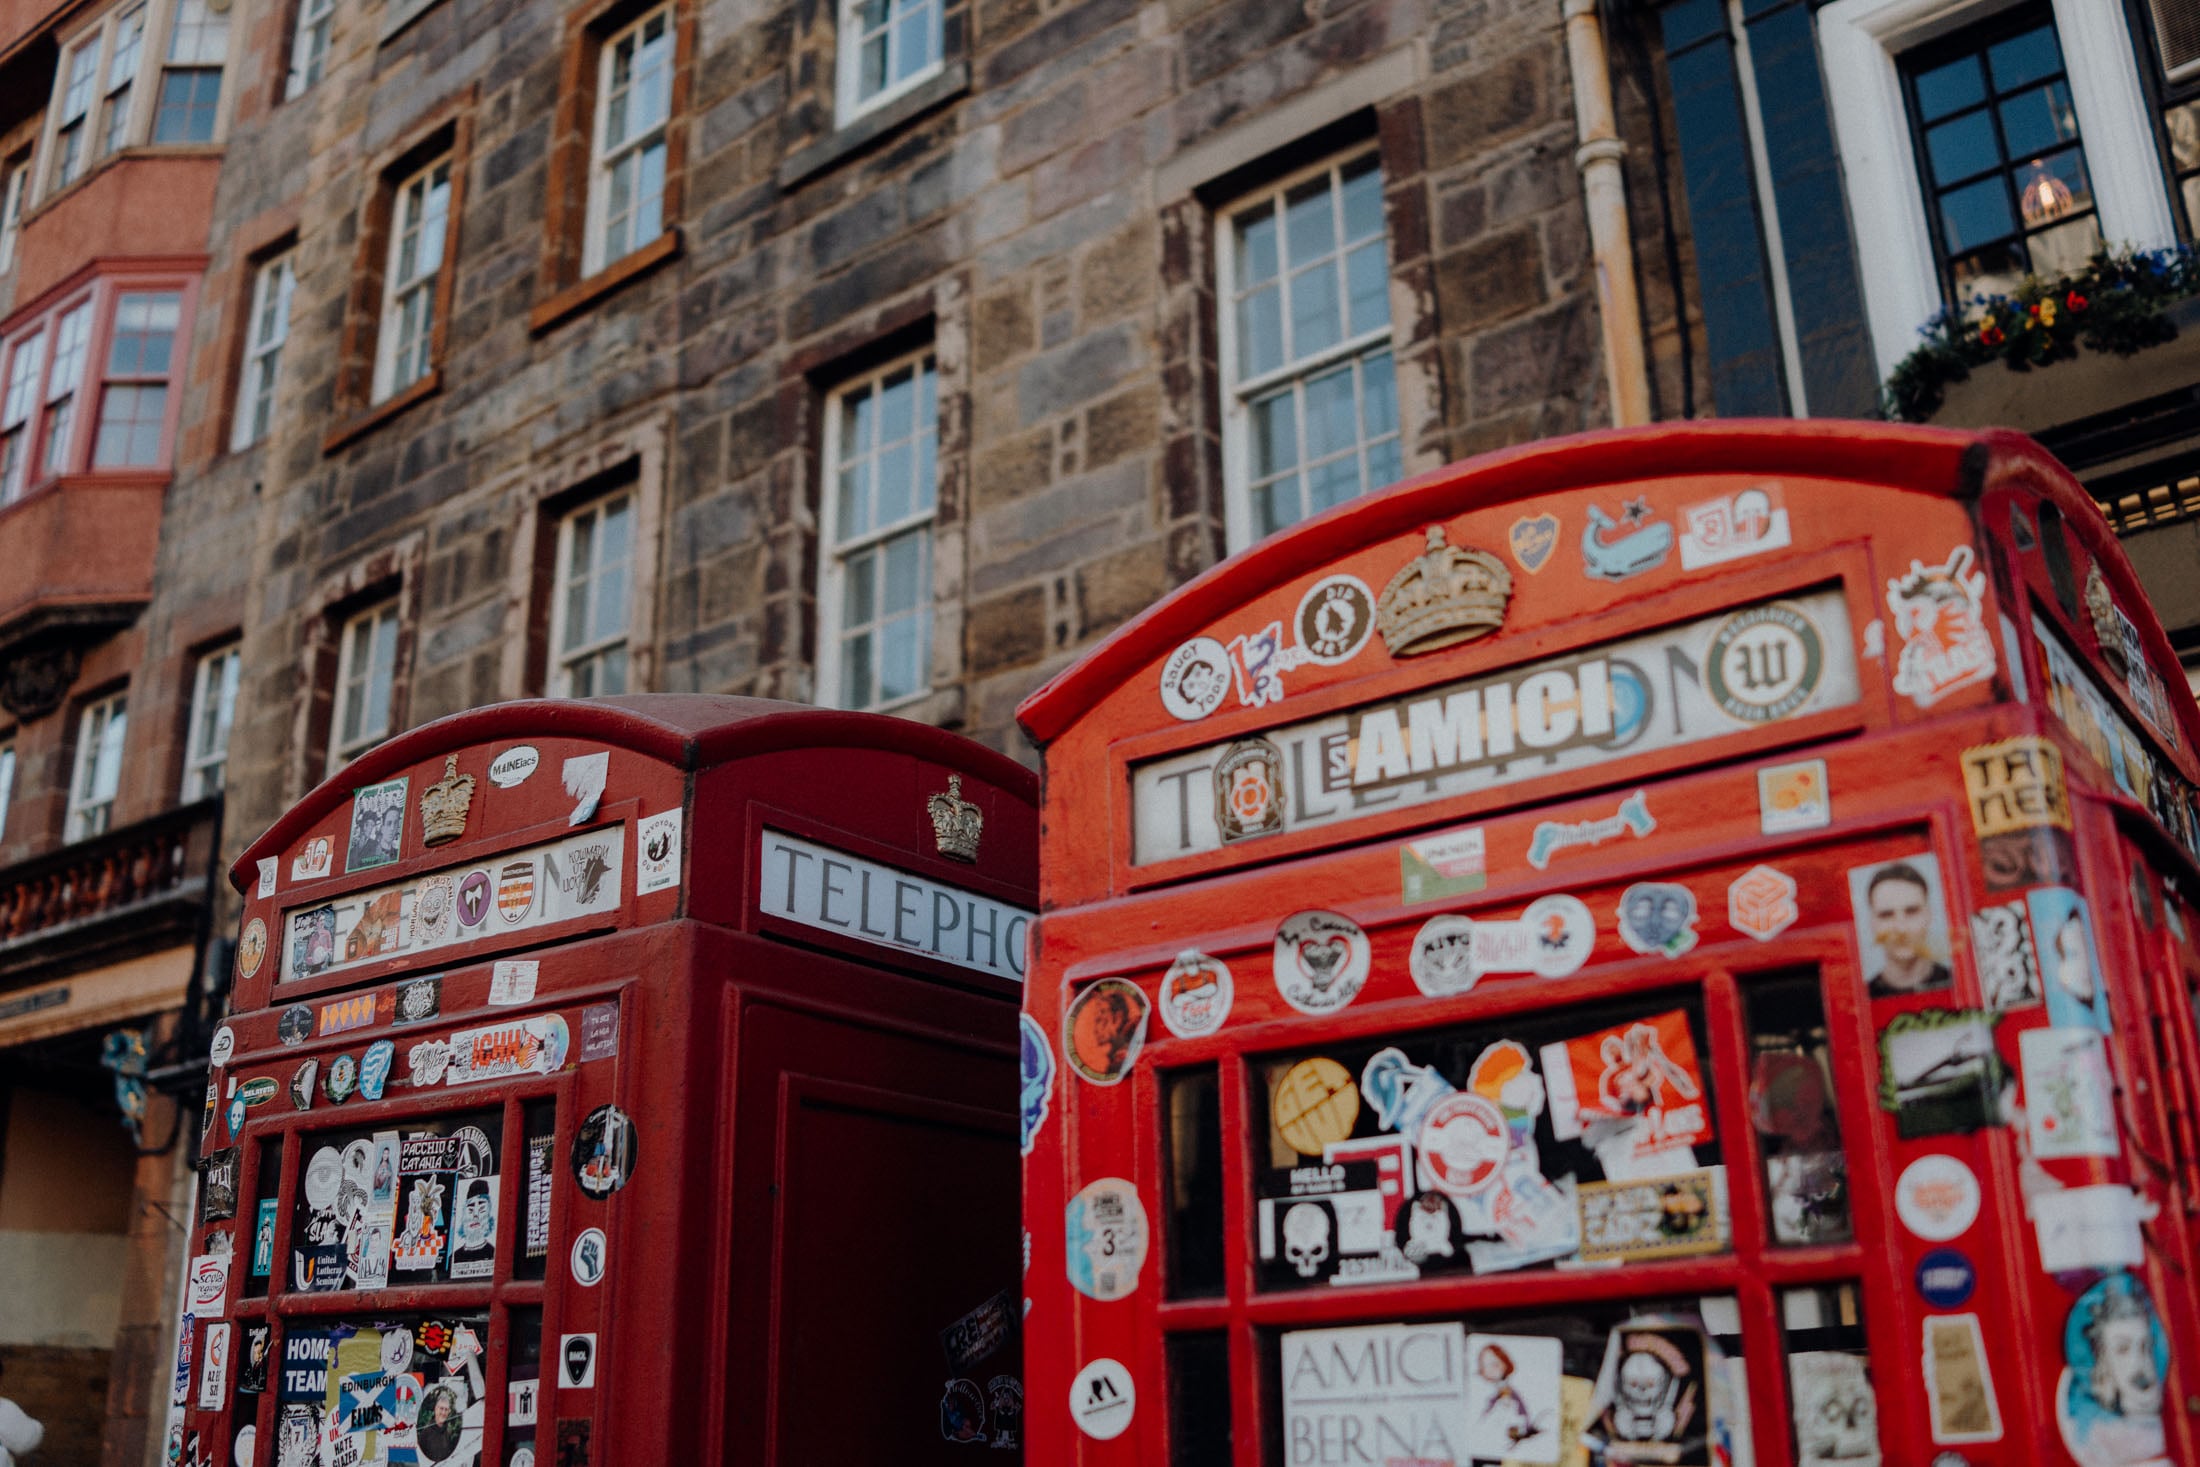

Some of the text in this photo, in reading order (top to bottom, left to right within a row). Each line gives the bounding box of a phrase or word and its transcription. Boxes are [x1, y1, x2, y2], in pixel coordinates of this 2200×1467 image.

[1354, 659, 1611, 785] AMICI
[402, 1141, 446, 1156] PACCHIO
[401, 1156, 442, 1171] CATANIA
[1103, 1228, 1116, 1256] 3
[317, 1255, 337, 1265] United
[287, 1339, 330, 1360] HOME
[1290, 1333, 1453, 1391] AMICI
[286, 1370, 327, 1392] TEAM
[342, 1375, 396, 1393] EDINBURGH
[334, 1436, 353, 1455] HATE
